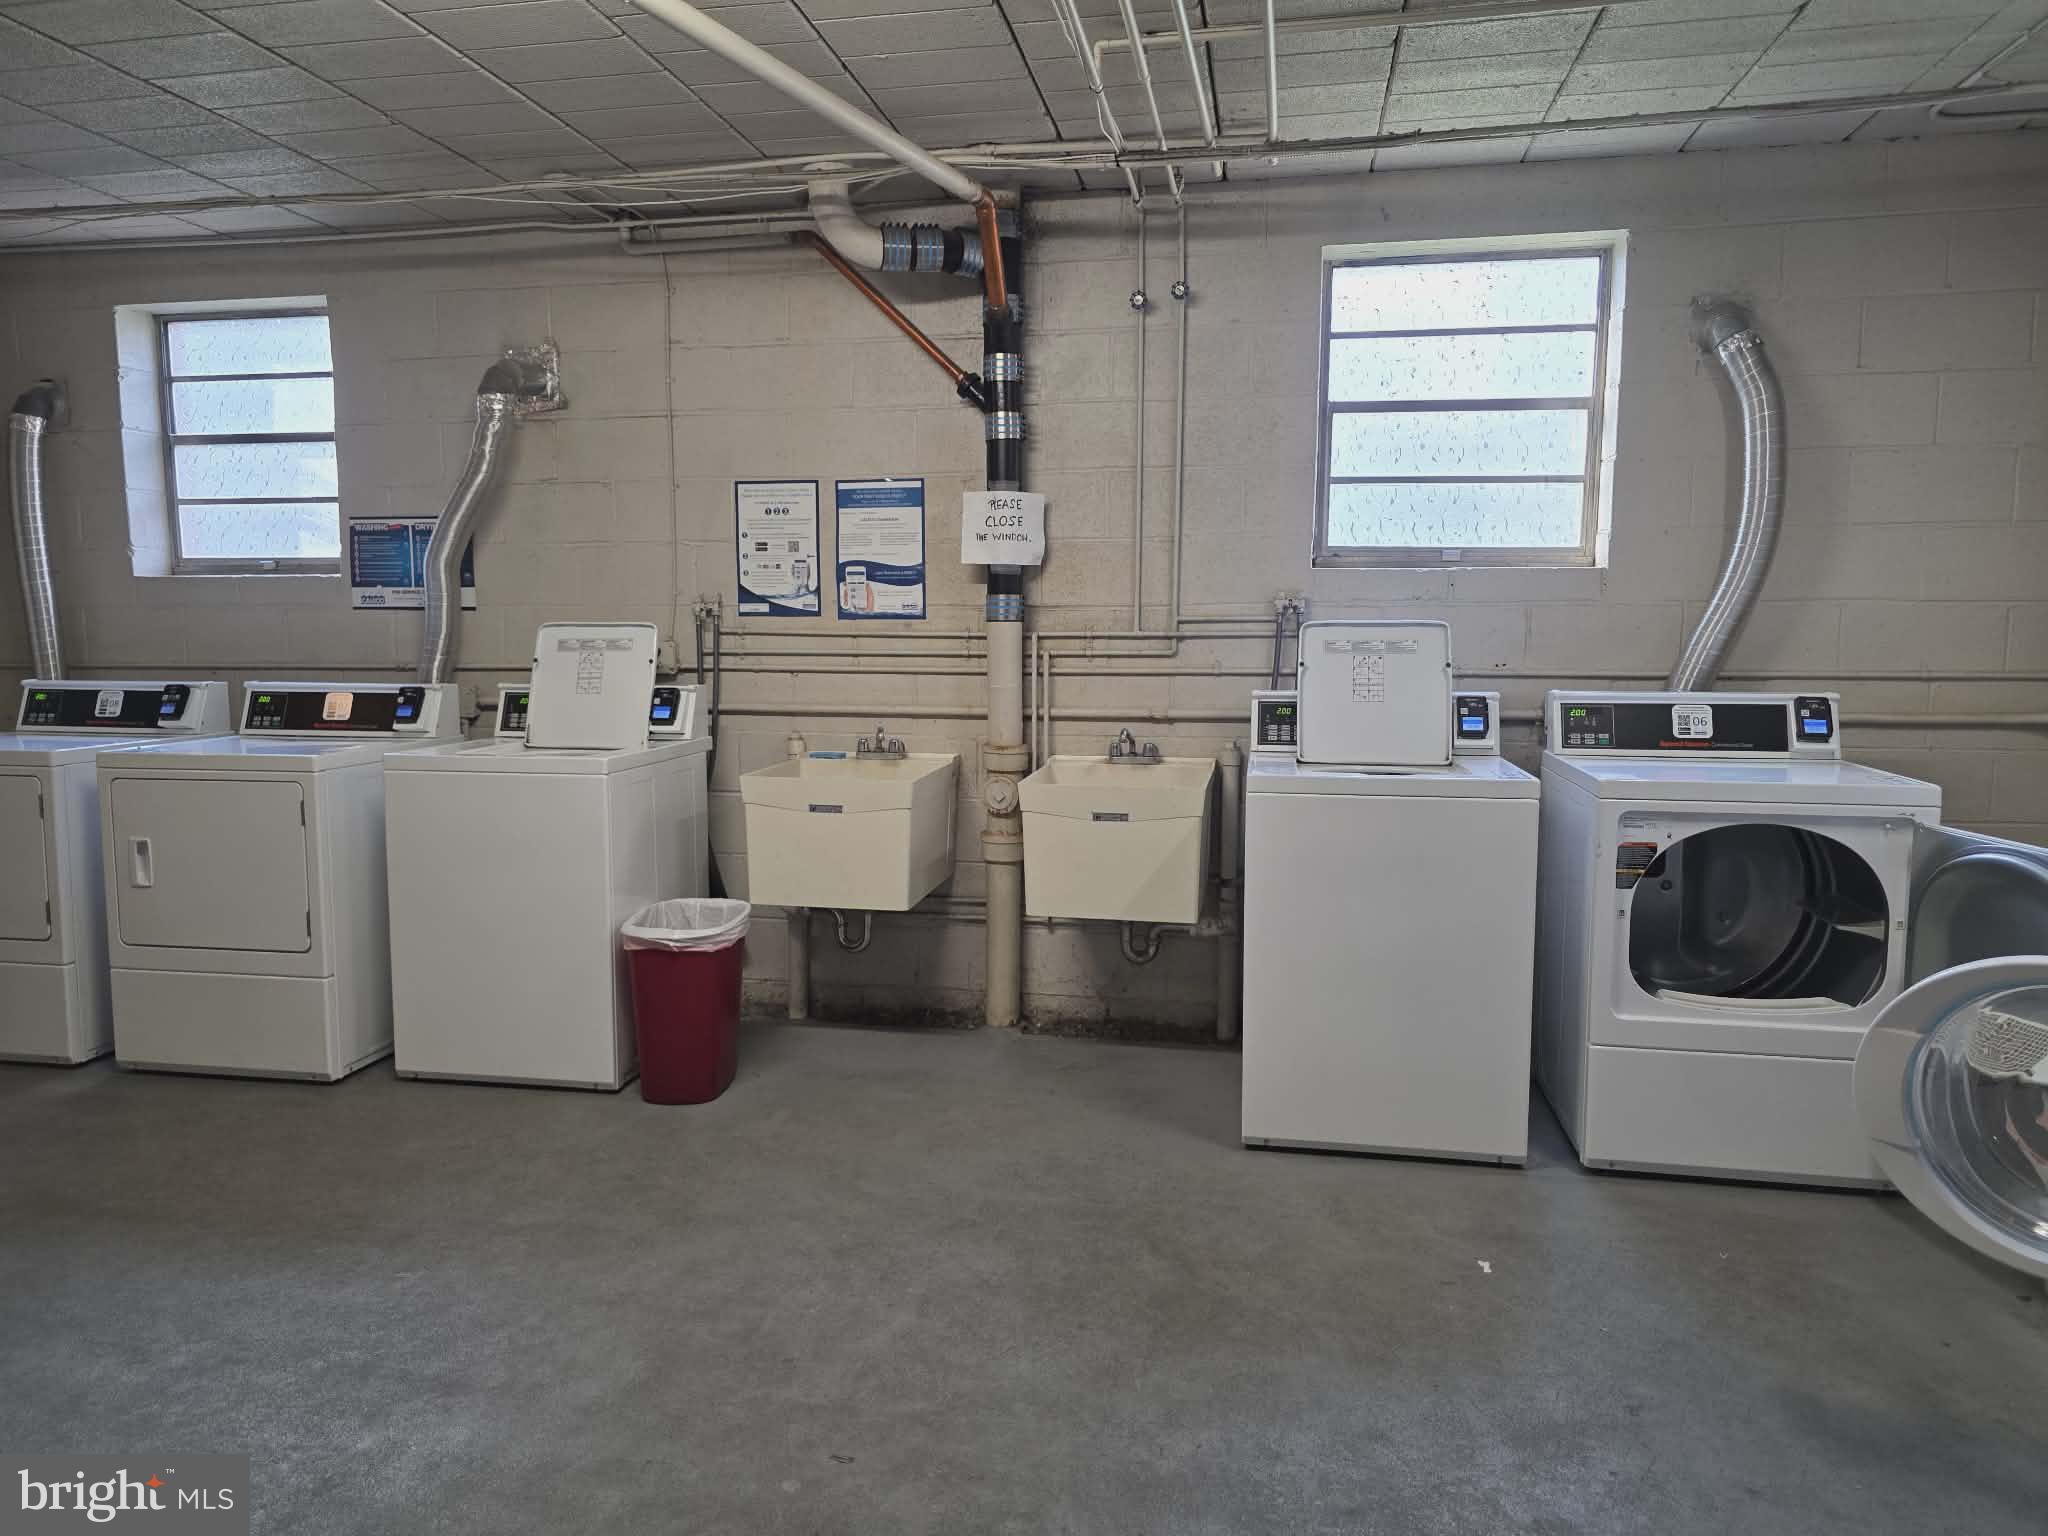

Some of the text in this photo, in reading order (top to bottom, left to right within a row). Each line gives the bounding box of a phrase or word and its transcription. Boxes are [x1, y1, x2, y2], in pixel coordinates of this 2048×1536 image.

[987, 497, 1023, 511] PLEASE
[985, 515, 1024, 528] CLOSE
[976, 533, 989, 543] THE
[1692, 716, 1708, 727] 06
